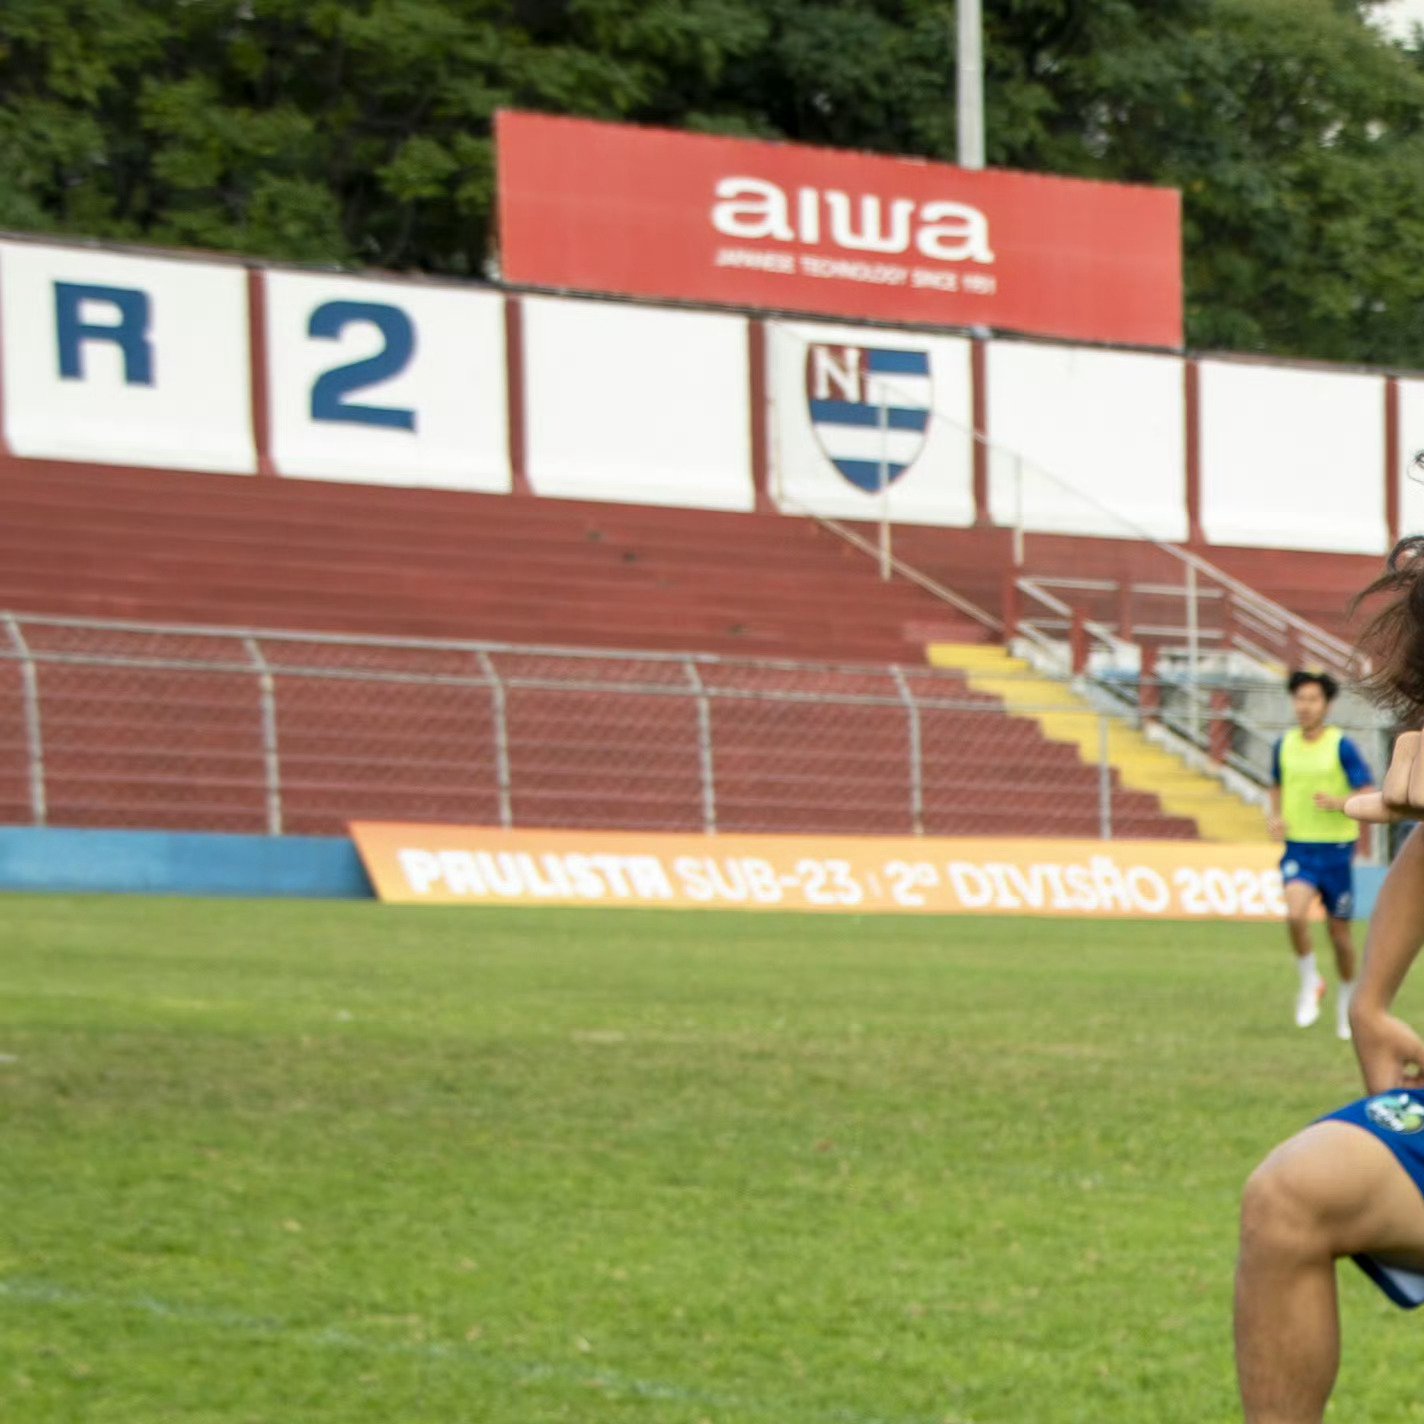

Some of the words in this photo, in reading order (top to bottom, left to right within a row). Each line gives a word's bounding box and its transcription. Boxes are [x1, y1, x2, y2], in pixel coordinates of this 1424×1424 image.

[711, 176, 995, 264] aiwa
[53, 279, 155, 387] R
[307, 299, 418, 432] 2
[397, 848, 674, 899] PAULISTA
[674, 856, 865, 906] SUB-23
[947, 854, 1171, 913] DIVISÃO
